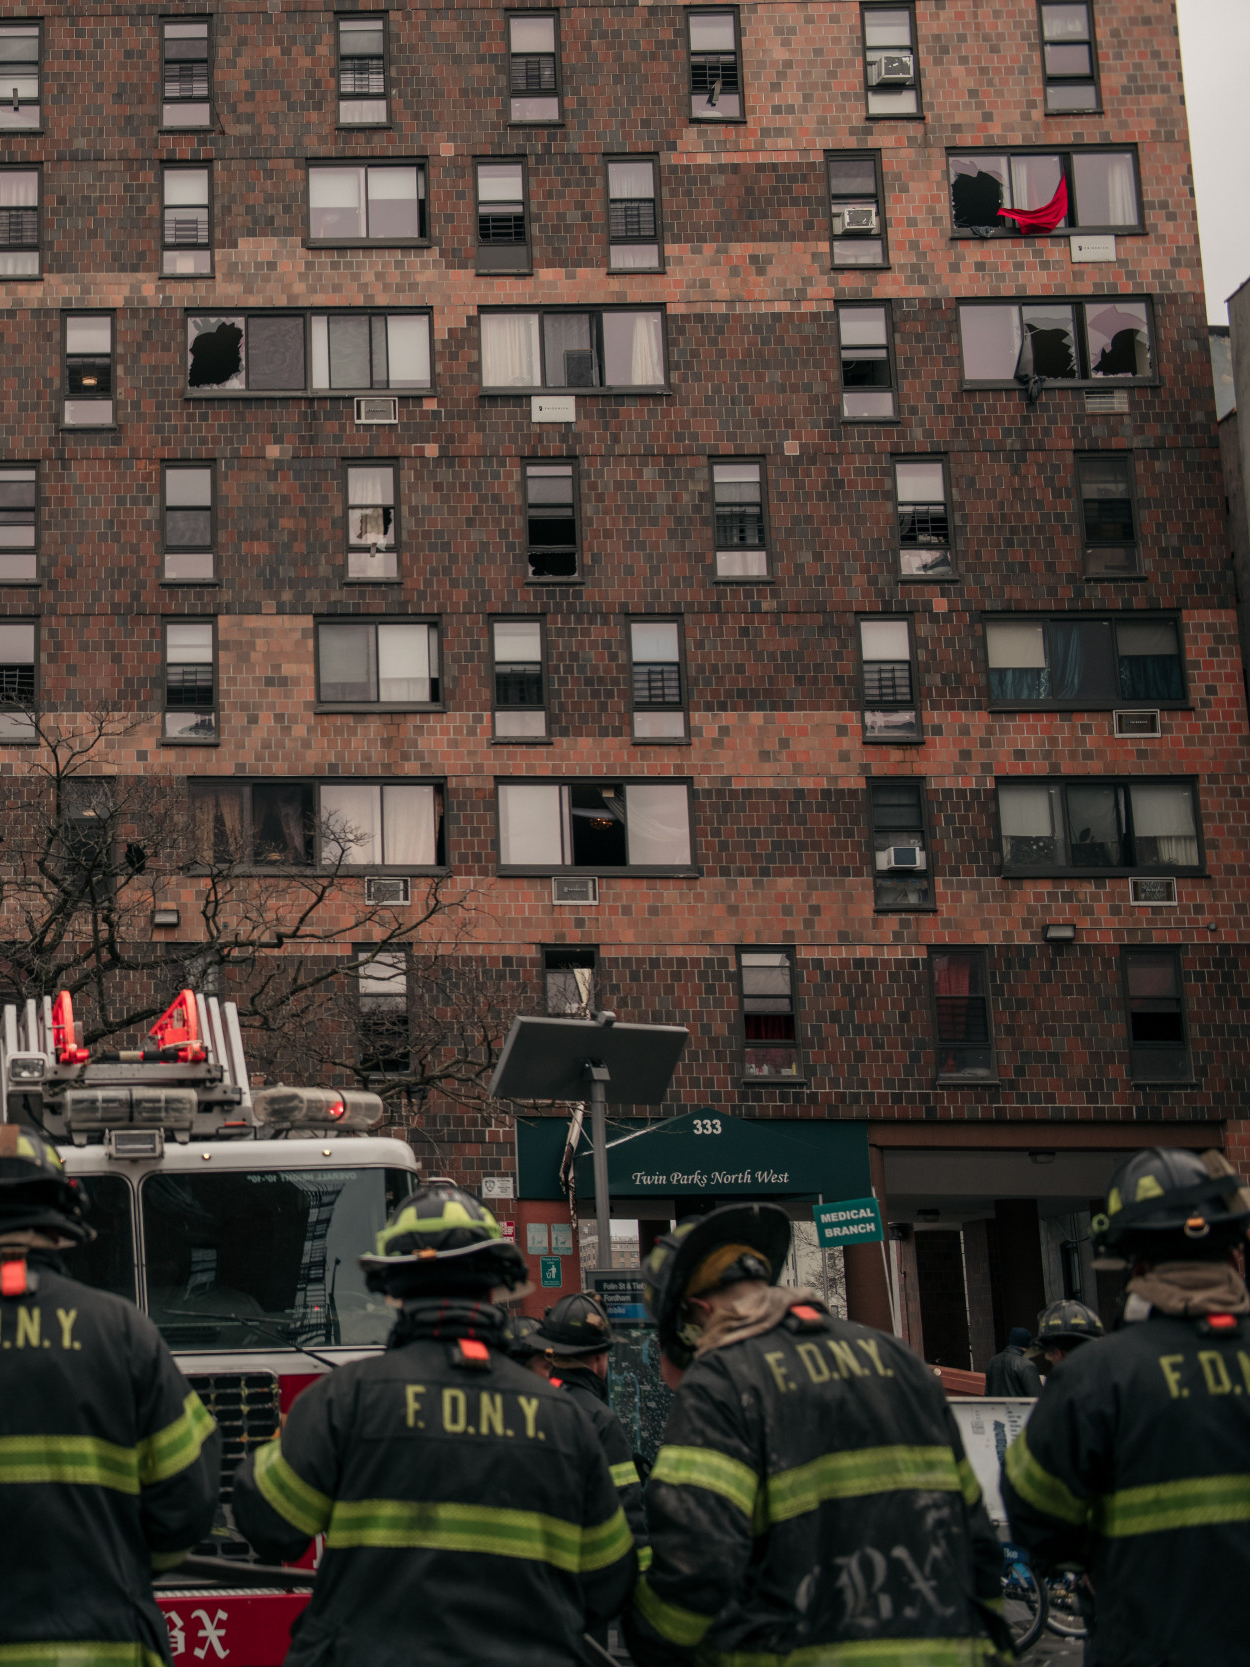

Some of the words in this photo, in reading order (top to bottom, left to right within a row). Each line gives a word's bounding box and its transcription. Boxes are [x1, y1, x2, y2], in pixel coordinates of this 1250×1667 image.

[692, 1119, 722, 1135] 333
[631, 1171, 667, 1185] Twin
[669, 1170, 708, 1187] Parks
[710, 1169, 752, 1185] North
[754, 1169, 789, 1184] West
[820, 1208, 875, 1223] MEDICAL
[824, 1222, 876, 1238] BRANCH
[604, 1294, 631, 1302] Fordham
[763, 1338, 895, 1393] F.D.N.Y.
[405, 1384, 546, 1441] F.D.N.Y.
